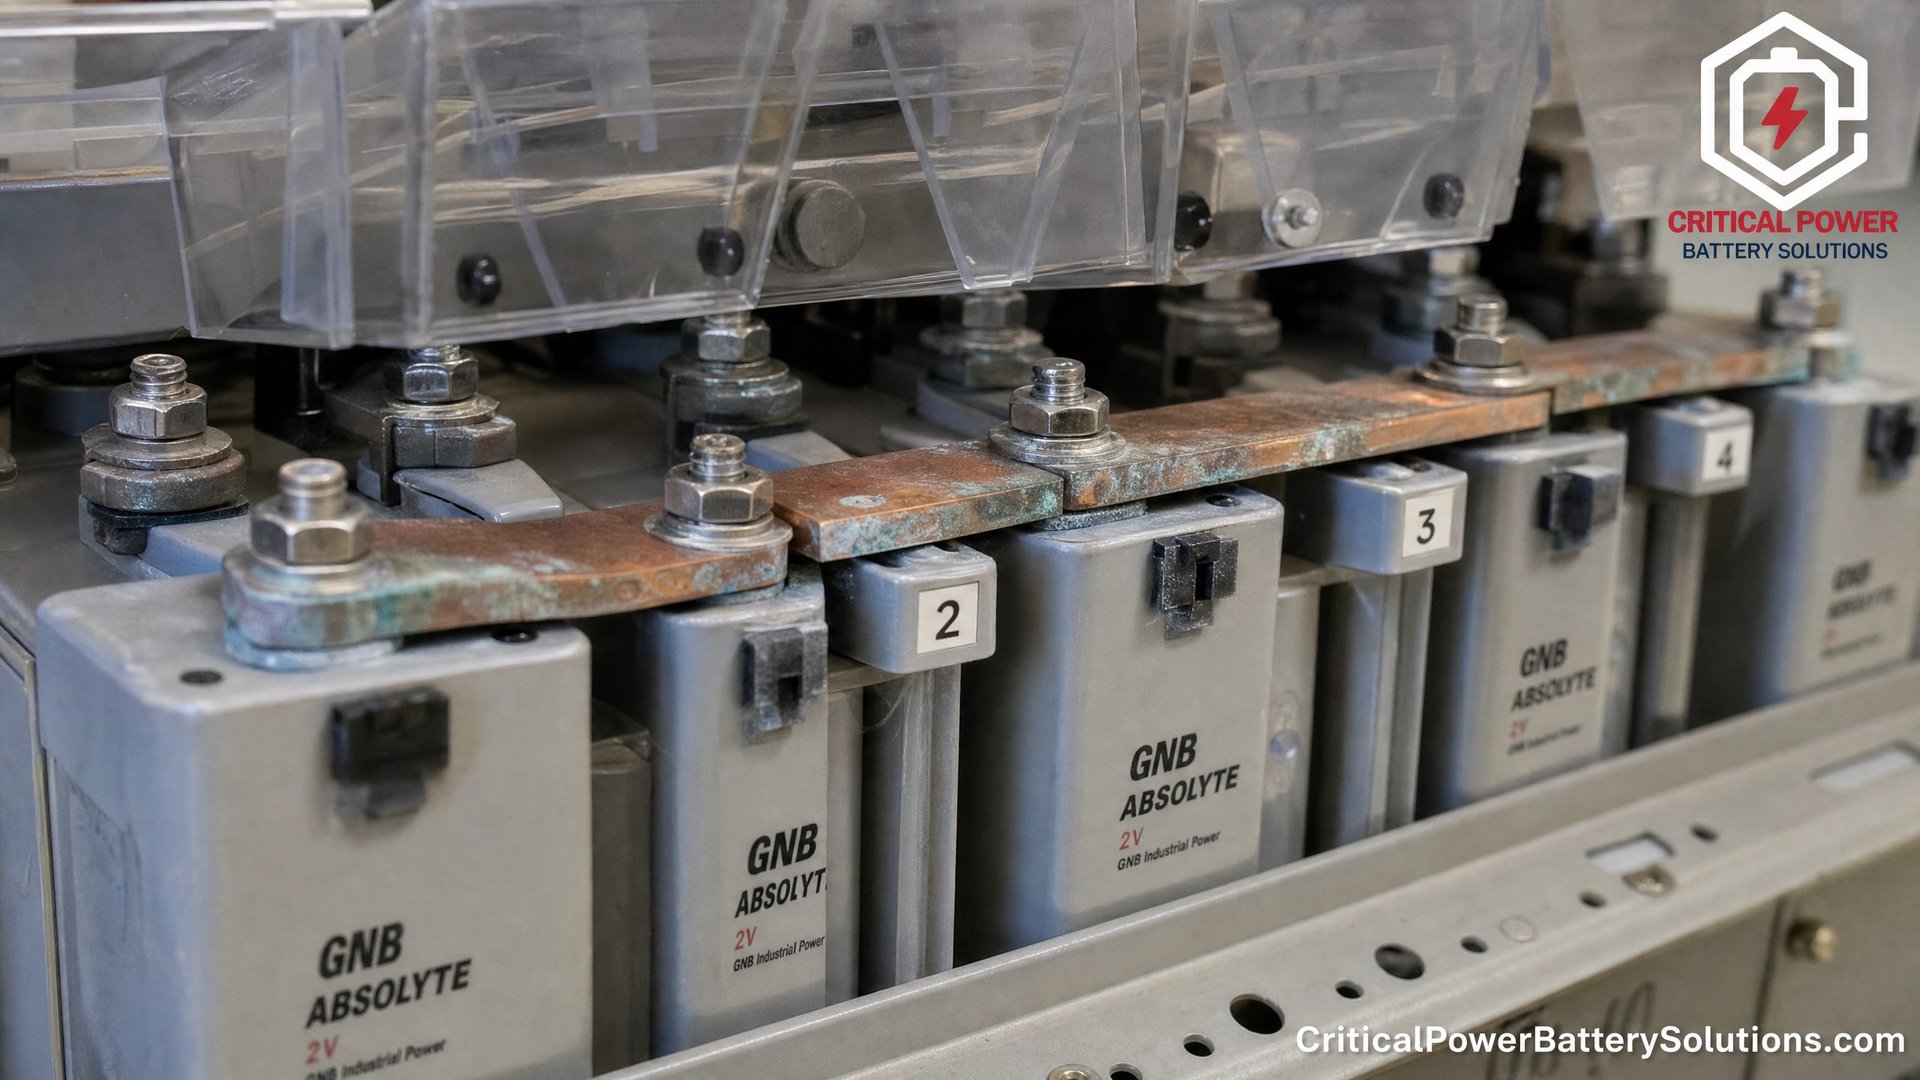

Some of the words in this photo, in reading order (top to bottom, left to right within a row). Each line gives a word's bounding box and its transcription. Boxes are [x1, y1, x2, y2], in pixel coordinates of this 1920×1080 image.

[1716, 441, 1733, 473] 4
[1417, 508, 1436, 545] 3
[936, 600, 960, 640] 2
[1520, 638, 1568, 677] GNB
[1510, 666, 1596, 712] ABSOLYTE
[1130, 733, 1197, 781] GNB
[1119, 764, 1240, 822] ABSOLYTE
[747, 823, 818, 875] GNB
[1117, 854, 1141, 871] GNB
[1144, 839, 1188, 863] Industrial
[1191, 831, 1221, 848] Power
[1119, 827, 1144, 850] 2V
[734, 867, 828, 918] ABSOLYT
[319, 921, 404, 979] GNB
[733, 955, 754, 972] GNB
[756, 941, 797, 966] Industrial
[798, 936, 825, 953] Power
[734, 926, 757, 950] 2V
[304, 957, 472, 1029] ABSOLYTE
[305, 1034, 340, 1065] 2V
[341, 1048, 401, 1078] Industrial
[404, 1039, 447, 1061] Power
